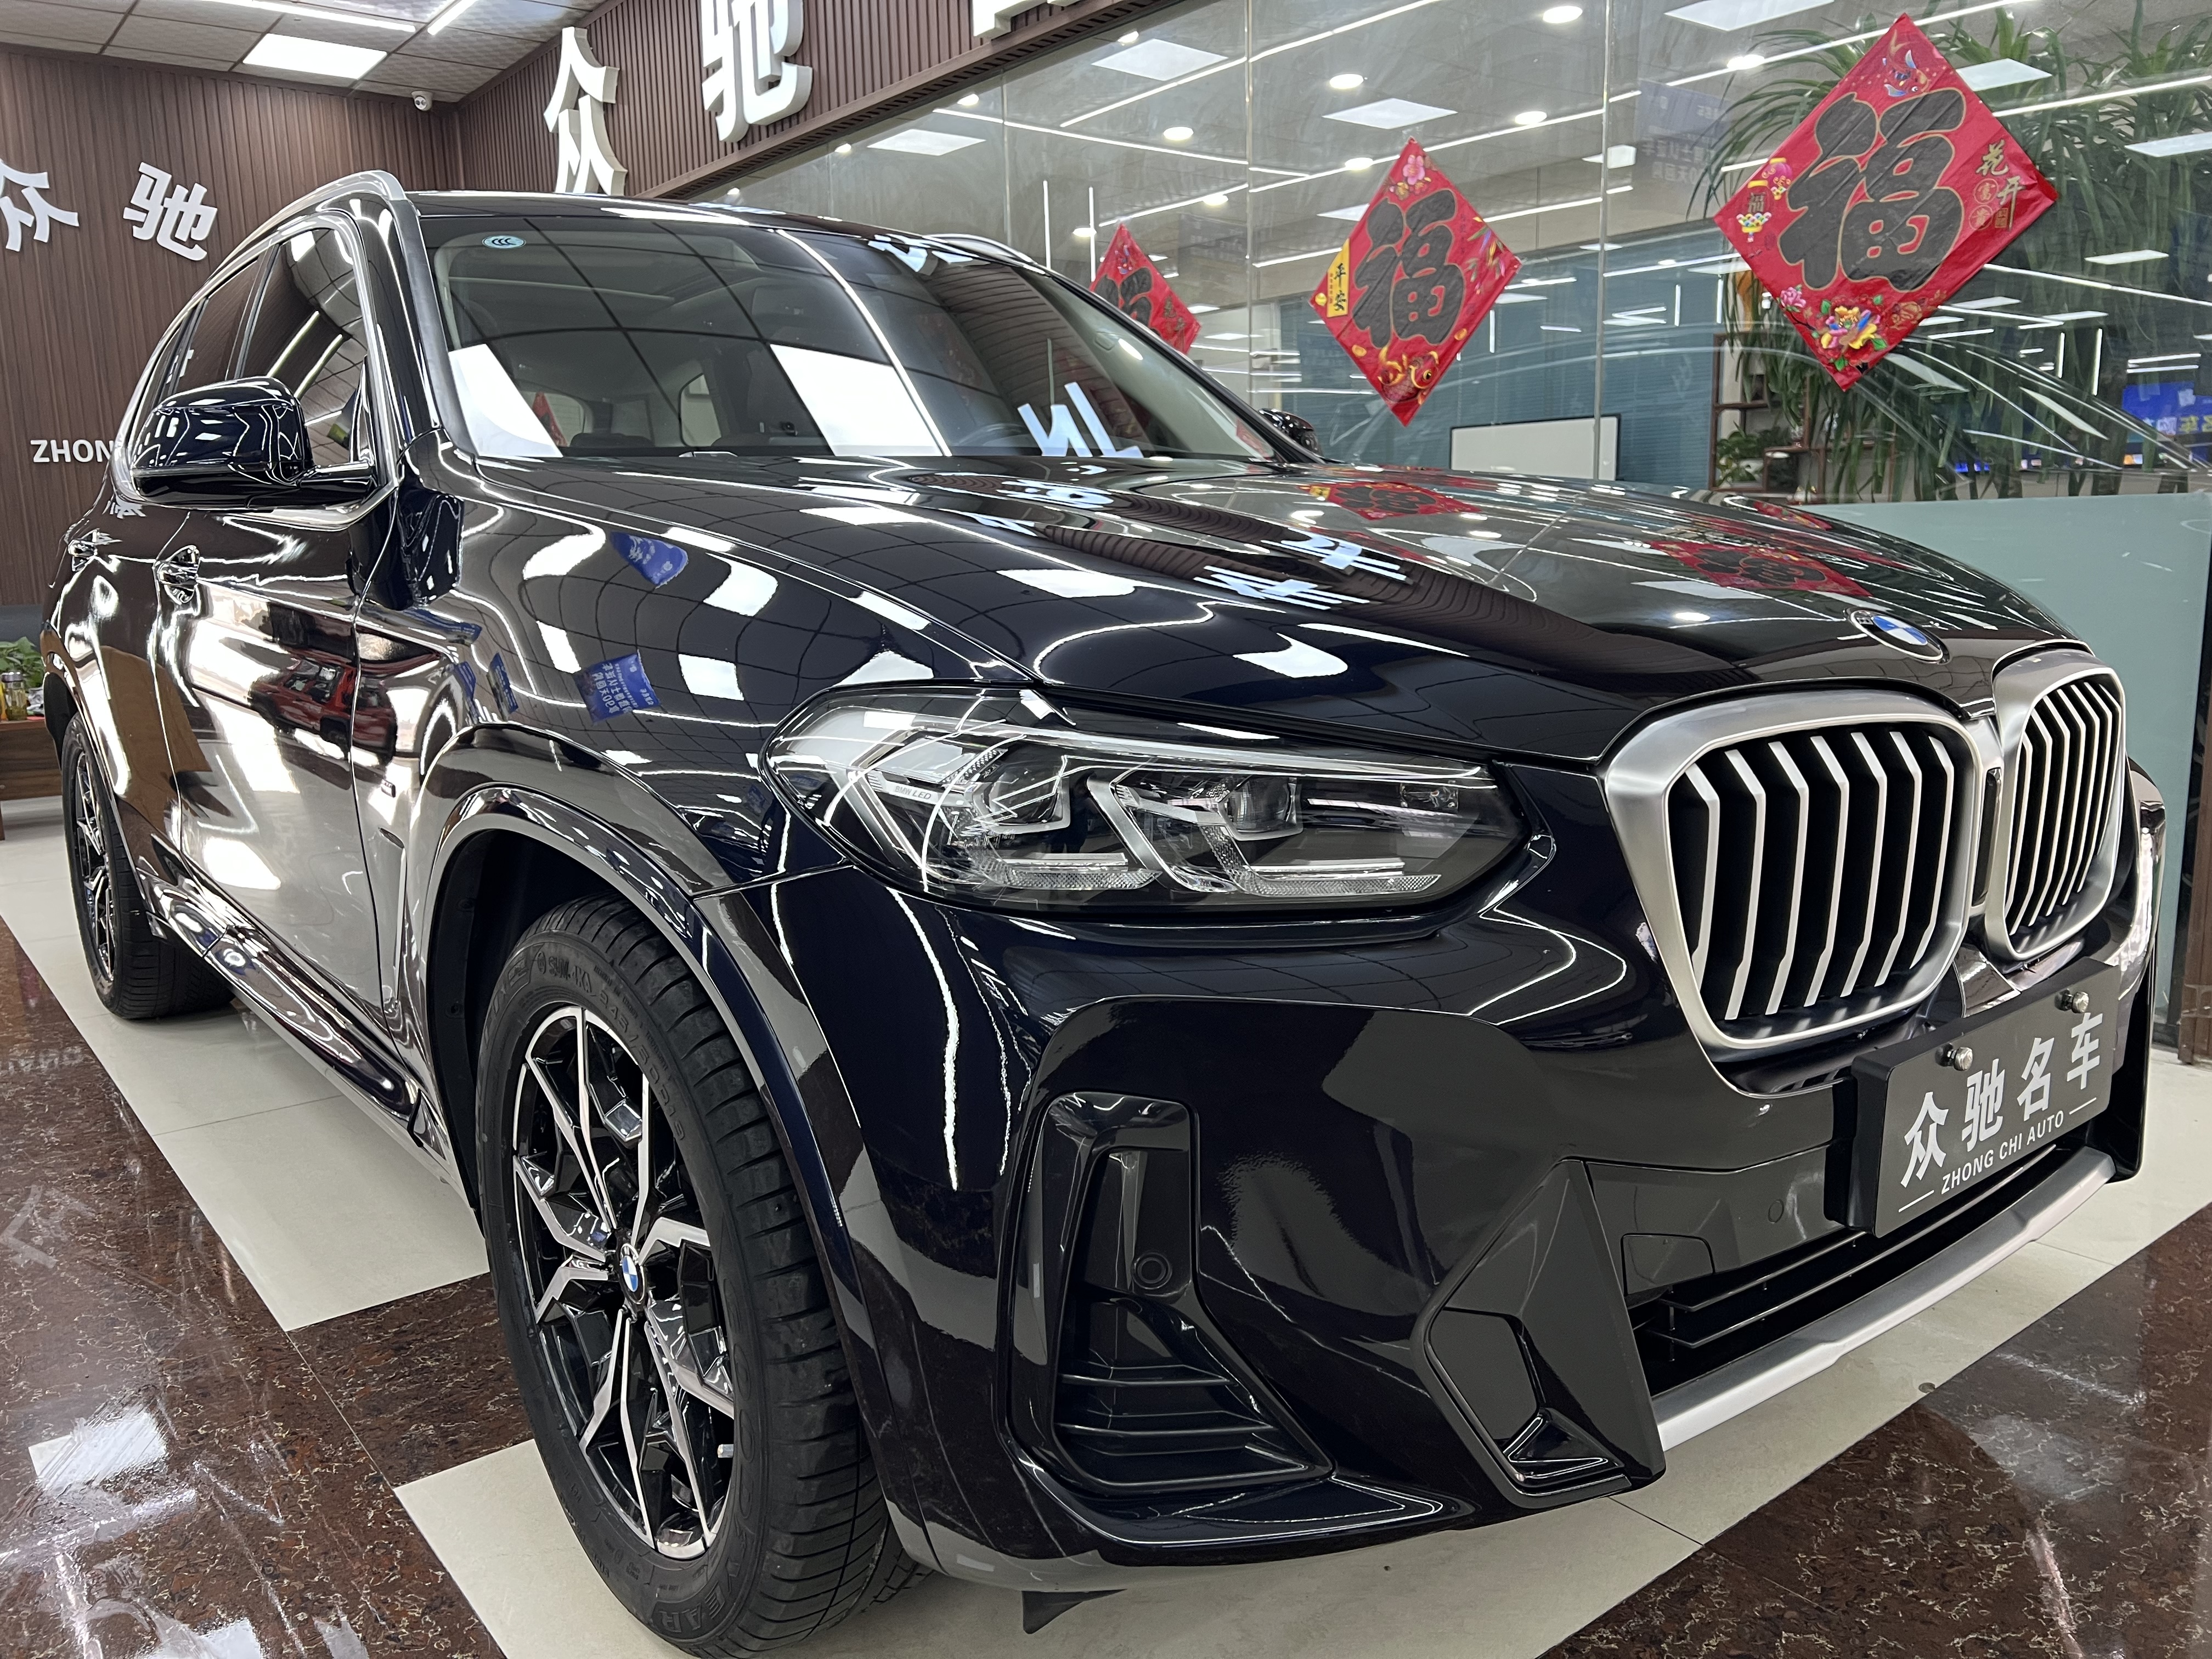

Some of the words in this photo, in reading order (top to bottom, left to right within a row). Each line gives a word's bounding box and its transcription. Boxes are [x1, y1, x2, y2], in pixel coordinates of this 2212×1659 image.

[1778, 88, 1966, 292] 福
[1334, 263, 1346, 311] 平安
[1352, 188, 1466, 348] 福
[895, 786, 912, 795] BMW
[912, 790, 932, 799] LED
[1900, 1012, 2103, 1188] 众驰名车
[1941, 1149, 1994, 1194] ZHONG
[1999, 1133, 2022, 1160] CHI
[2027, 1110, 2064, 1146] AUTO
